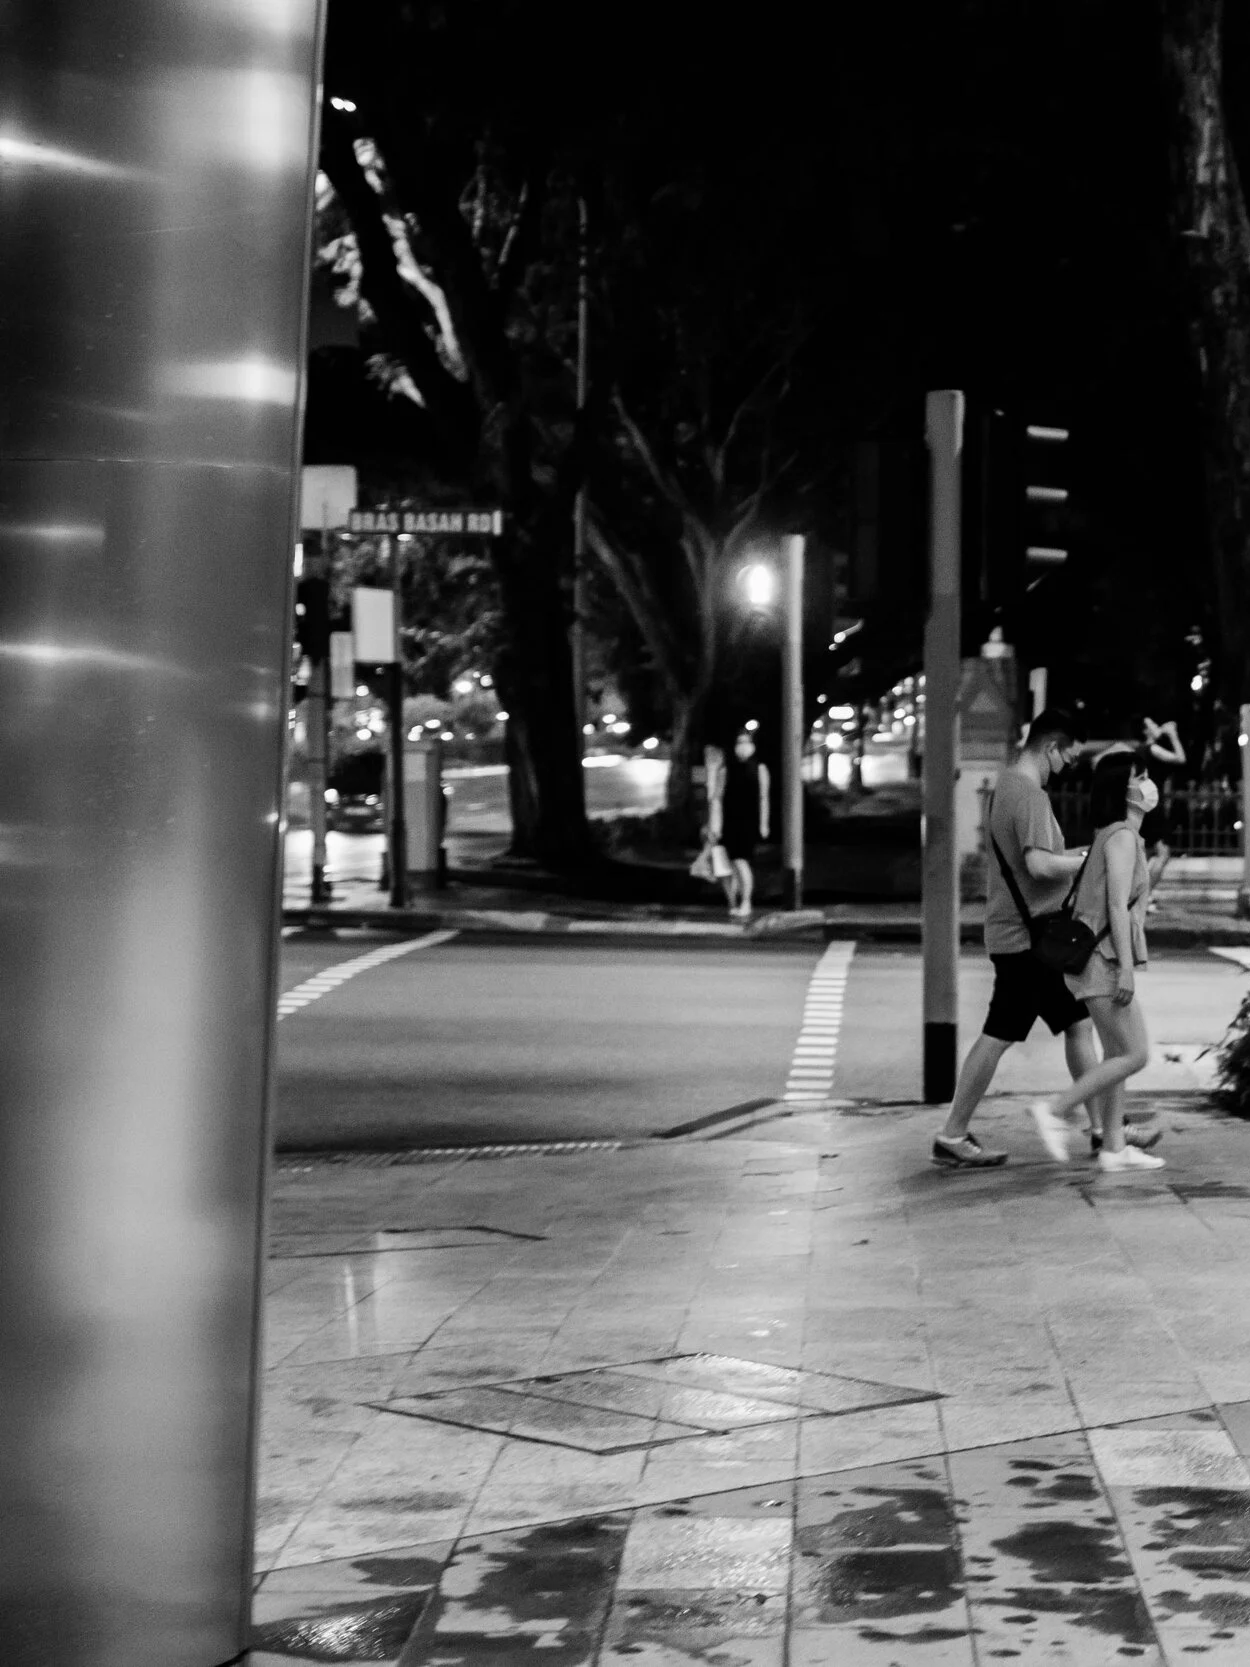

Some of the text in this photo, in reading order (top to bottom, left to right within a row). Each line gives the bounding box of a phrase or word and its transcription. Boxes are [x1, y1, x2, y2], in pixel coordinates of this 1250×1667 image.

[351, 511, 491, 533] BRAS BASAH RD
